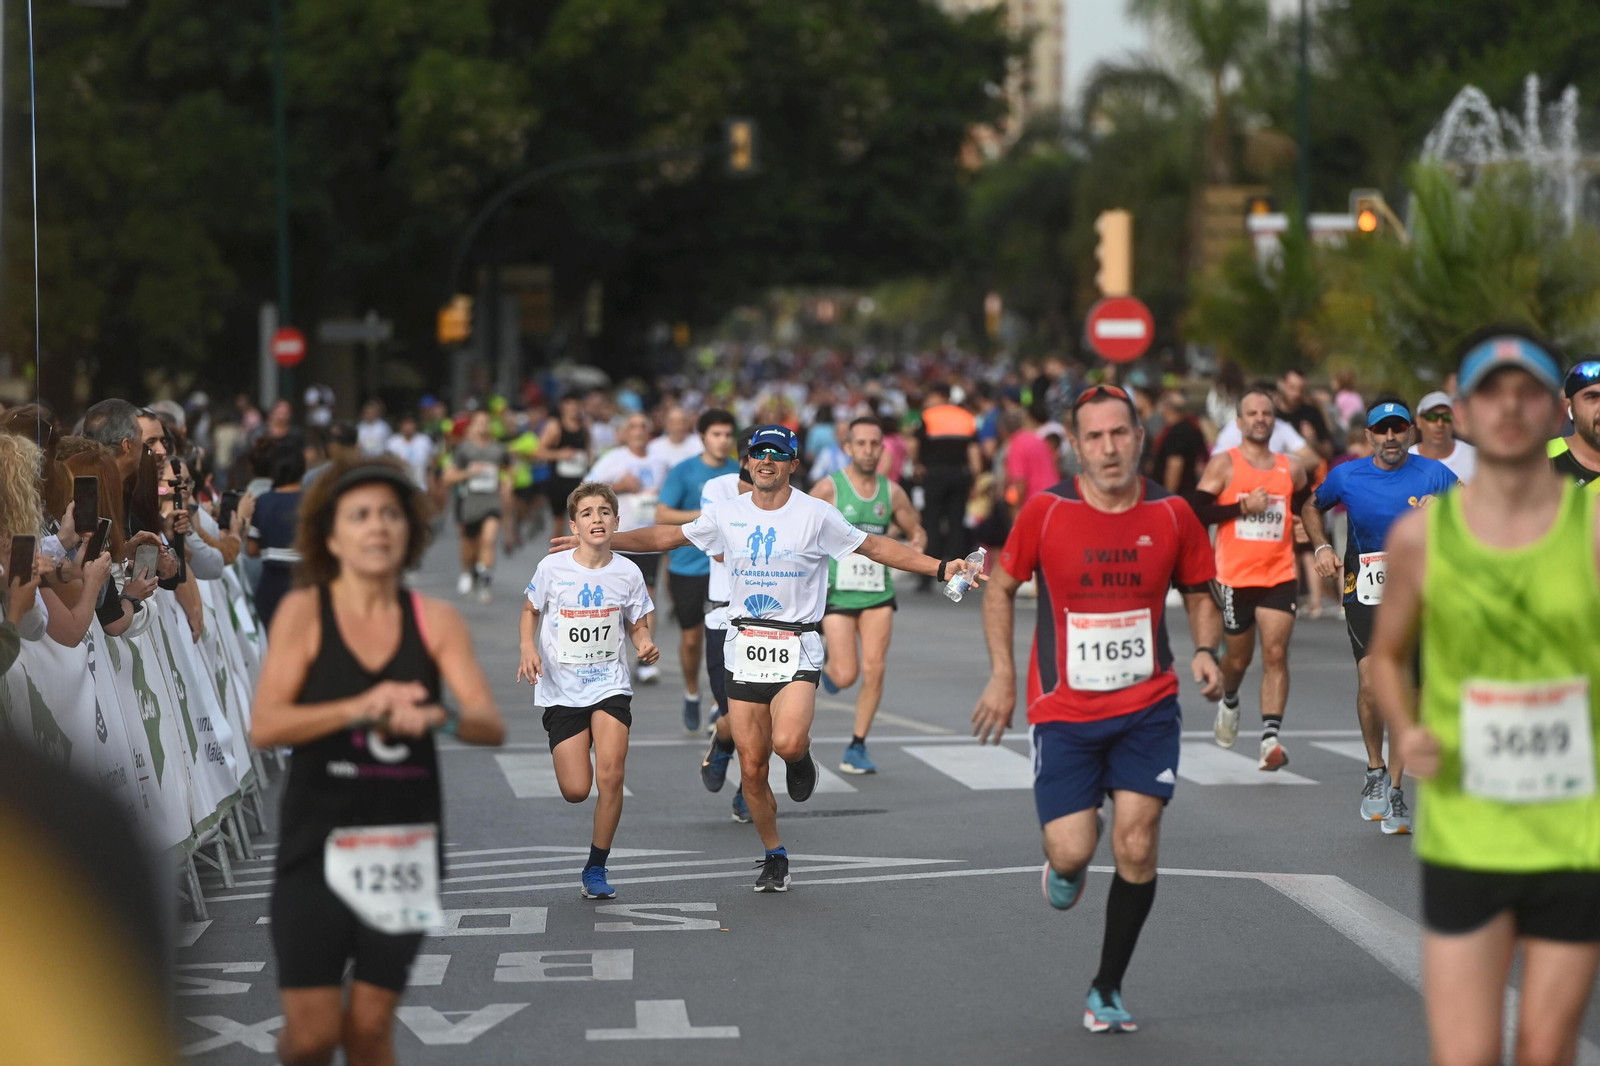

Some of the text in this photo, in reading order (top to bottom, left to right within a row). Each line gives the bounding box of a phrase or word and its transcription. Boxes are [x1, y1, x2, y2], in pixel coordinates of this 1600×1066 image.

[1083, 548, 1138, 563] SWIM
[740, 569, 770, 578] CARRERA
[770, 570, 799, 578] URBANA
[852, 563, 876, 577] 135
[1080, 572, 1142, 587] & RUN
[1366, 571, 1386, 586] 16
[560, 609, 574, 618] 42
[568, 625, 611, 643] 6017
[746, 645, 790, 664] 6018
[1076, 637, 1146, 661] 11653
[1484, 721, 1570, 758] 3689
[352, 861, 424, 893] 1255
